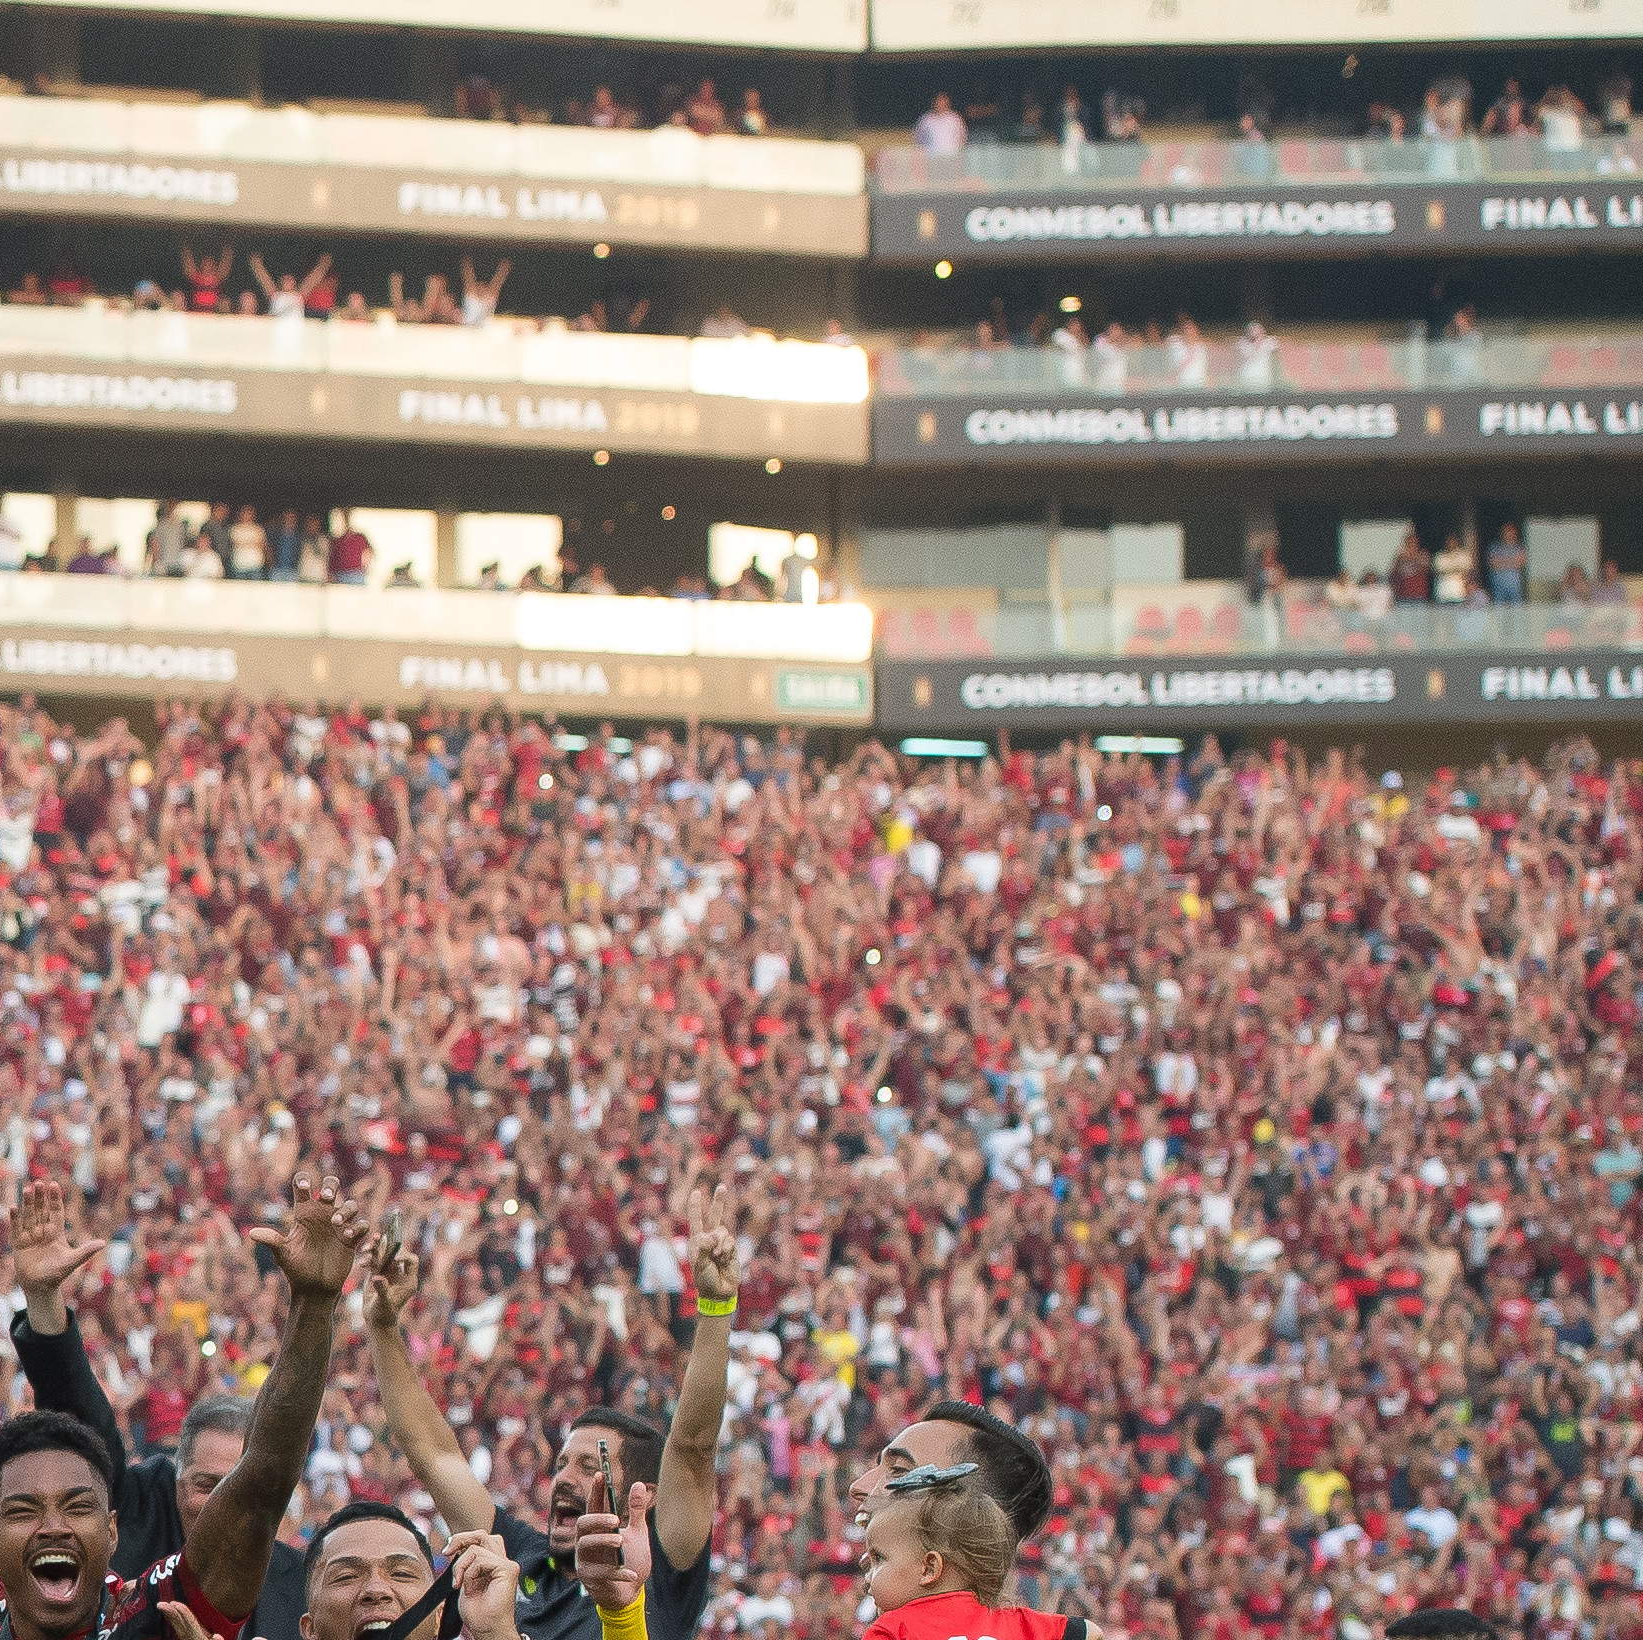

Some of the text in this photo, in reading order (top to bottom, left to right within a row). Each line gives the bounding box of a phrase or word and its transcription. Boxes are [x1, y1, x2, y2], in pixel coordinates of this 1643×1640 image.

[3, 158, 238, 205] LIBERTADORES
[397, 182, 510, 220] FINAL
[514, 188, 607, 223] LIMA
[965, 200, 1396, 242] CONMEBOL LIBERTADORES
[1480, 197, 1599, 231] FINAL
[0, 370, 237, 414] LIBERTADORES
[399, 389, 511, 428] FINAL
[516, 396, 607, 431] LIMA
[964, 403, 1398, 445] CONMEBOL LIBERTADORES
[1479, 400, 1643, 437] FINAL LI
[0, 637, 237, 682] LIBERTADORES
[400, 654, 511, 694] FINAL
[517, 660, 609, 697] LIMA
[961, 668, 1394, 709] CONMEBOL LIBERTADORES
[1481, 666, 1600, 700] FINAL
